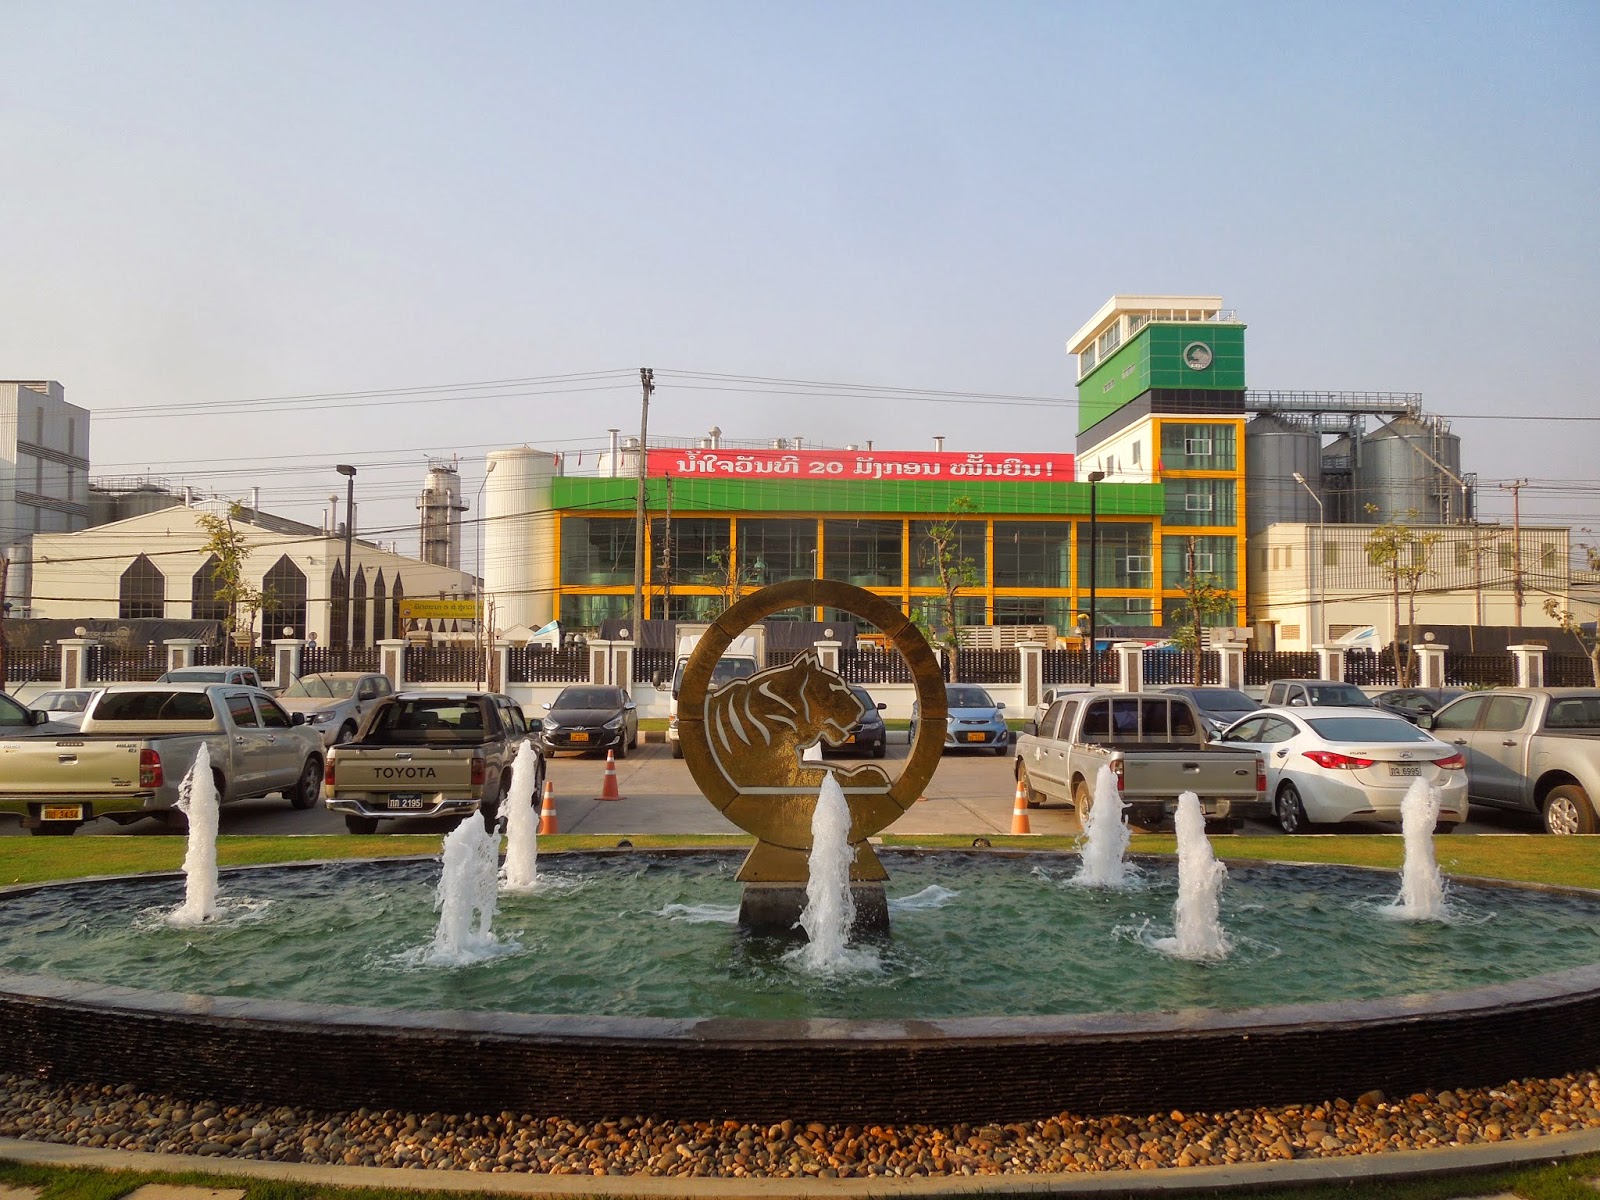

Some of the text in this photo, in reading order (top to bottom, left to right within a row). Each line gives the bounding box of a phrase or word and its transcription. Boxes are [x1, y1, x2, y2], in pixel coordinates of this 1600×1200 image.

[808, 461, 844, 474] 20
[853, 456, 941, 479] ມັງກອນ
[373, 767, 437, 779] TOYOTA
[401, 799, 421, 808] 2195
